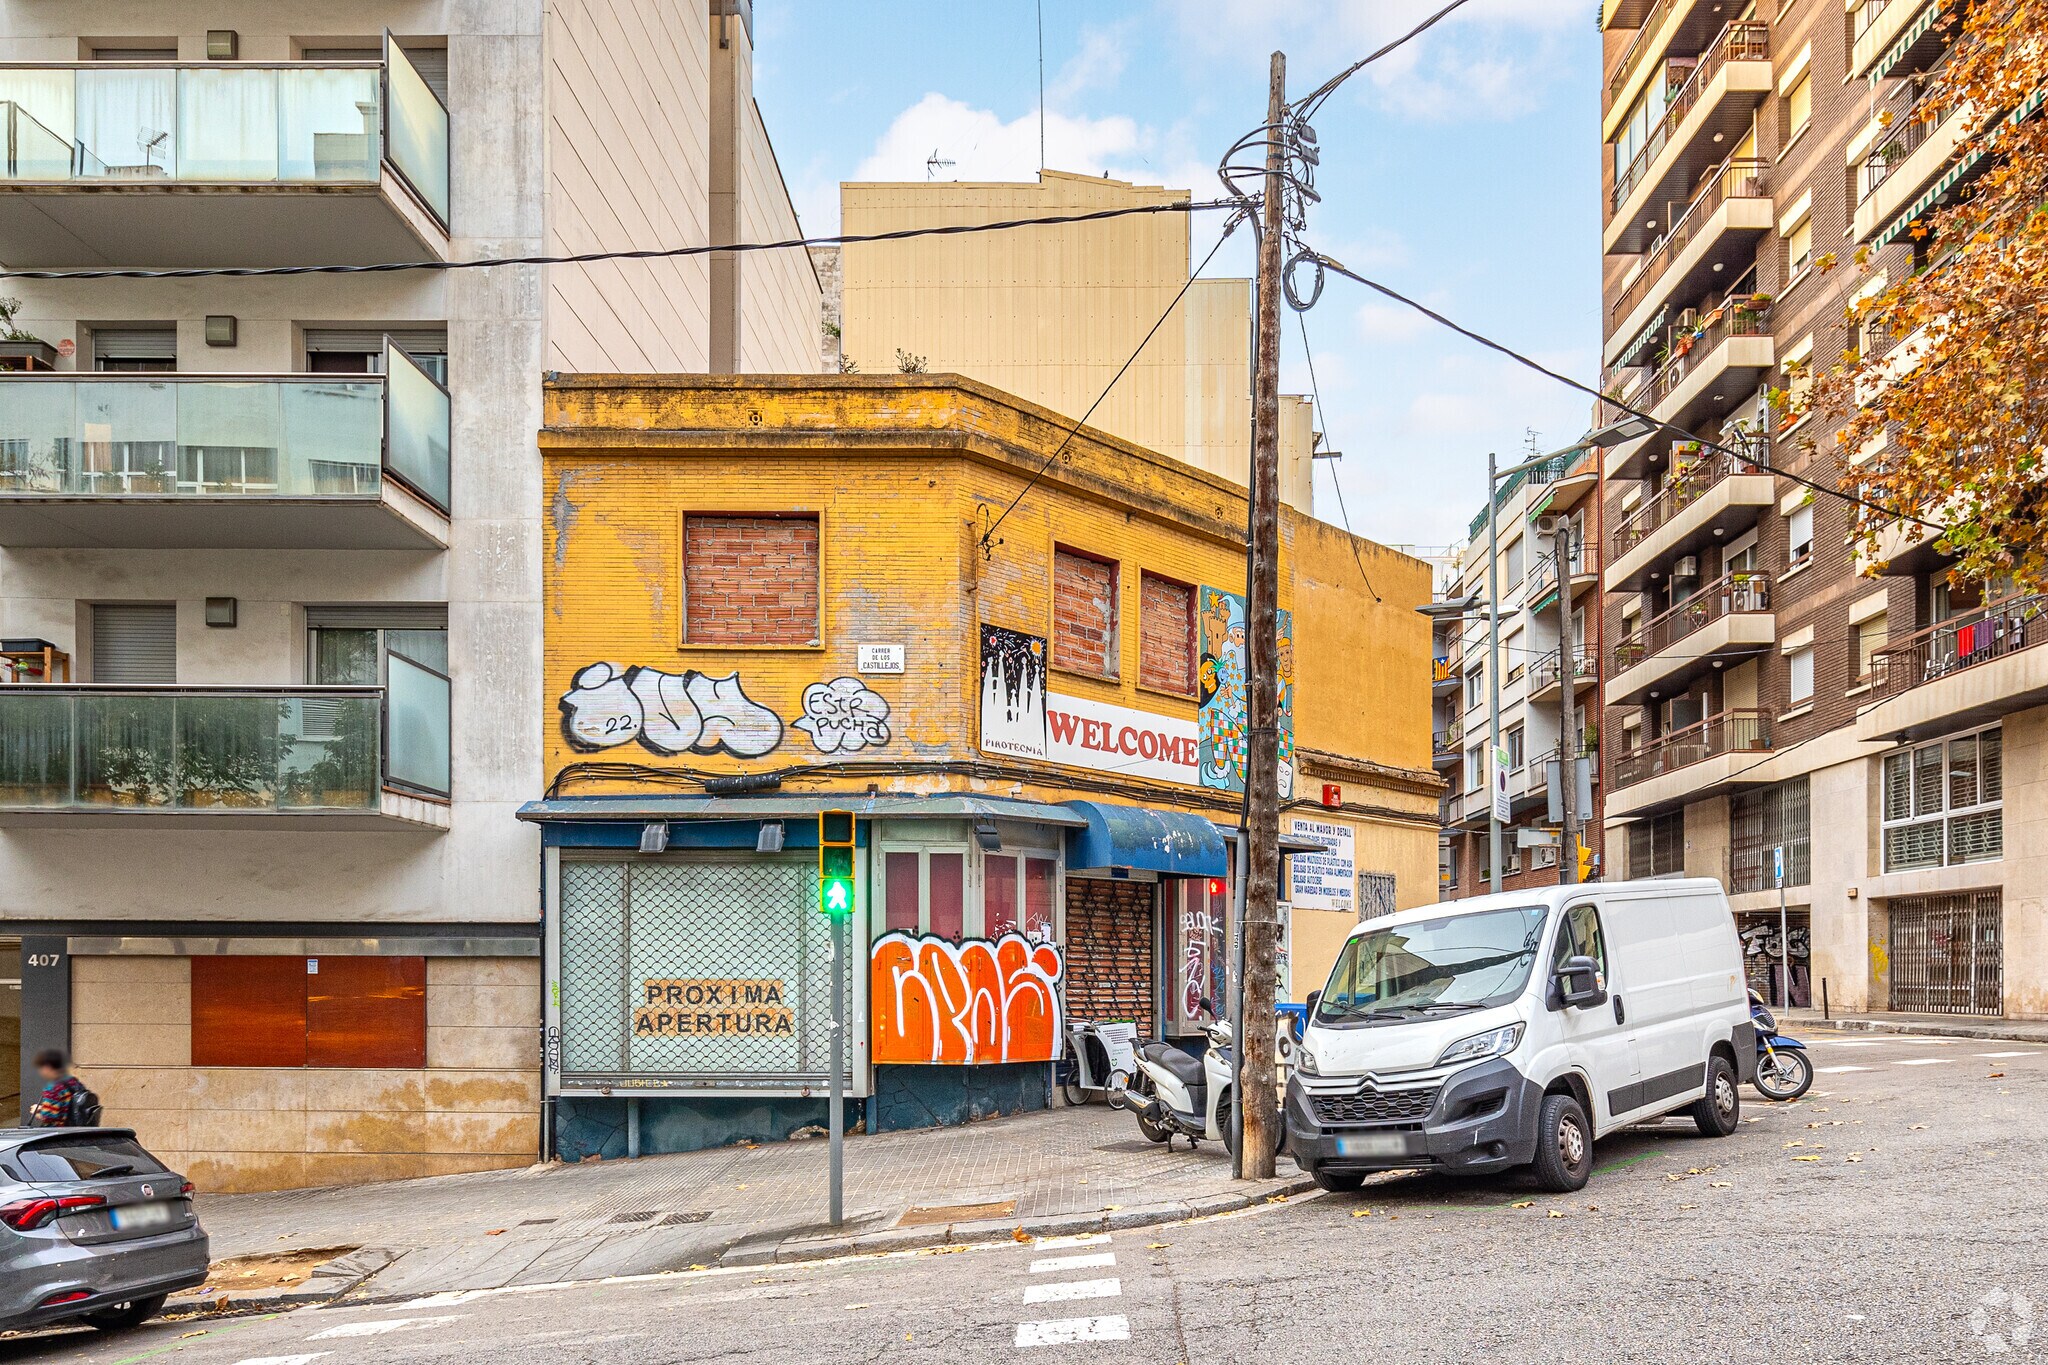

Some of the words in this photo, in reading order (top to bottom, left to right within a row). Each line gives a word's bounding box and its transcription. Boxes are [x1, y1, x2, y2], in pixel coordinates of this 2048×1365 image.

[862, 661, 899, 669] CASTILLEJOS
[1047, 710, 1199, 768] WELCOME
[985, 738, 1043, 756] PIROTECNIA
[1294, 821, 1308, 831] VENTA
[1309, 823, 1315, 832] AL
[1316, 824, 1331, 835] MAYOR
[1337, 826, 1351, 837] DETALL
[1293, 854, 1306, 863] BOLSAS
[1322, 857, 1327, 866] DE
[1293, 864, 1306, 873] BOLSAS
[1307, 865, 1311, 874] DE
[1293, 874, 1306, 883] BOLSAS
[28, 954, 60, 967] 407
[647, 985, 782, 1005] PROXIMA
[636, 1013, 792, 1033] APERTURA
